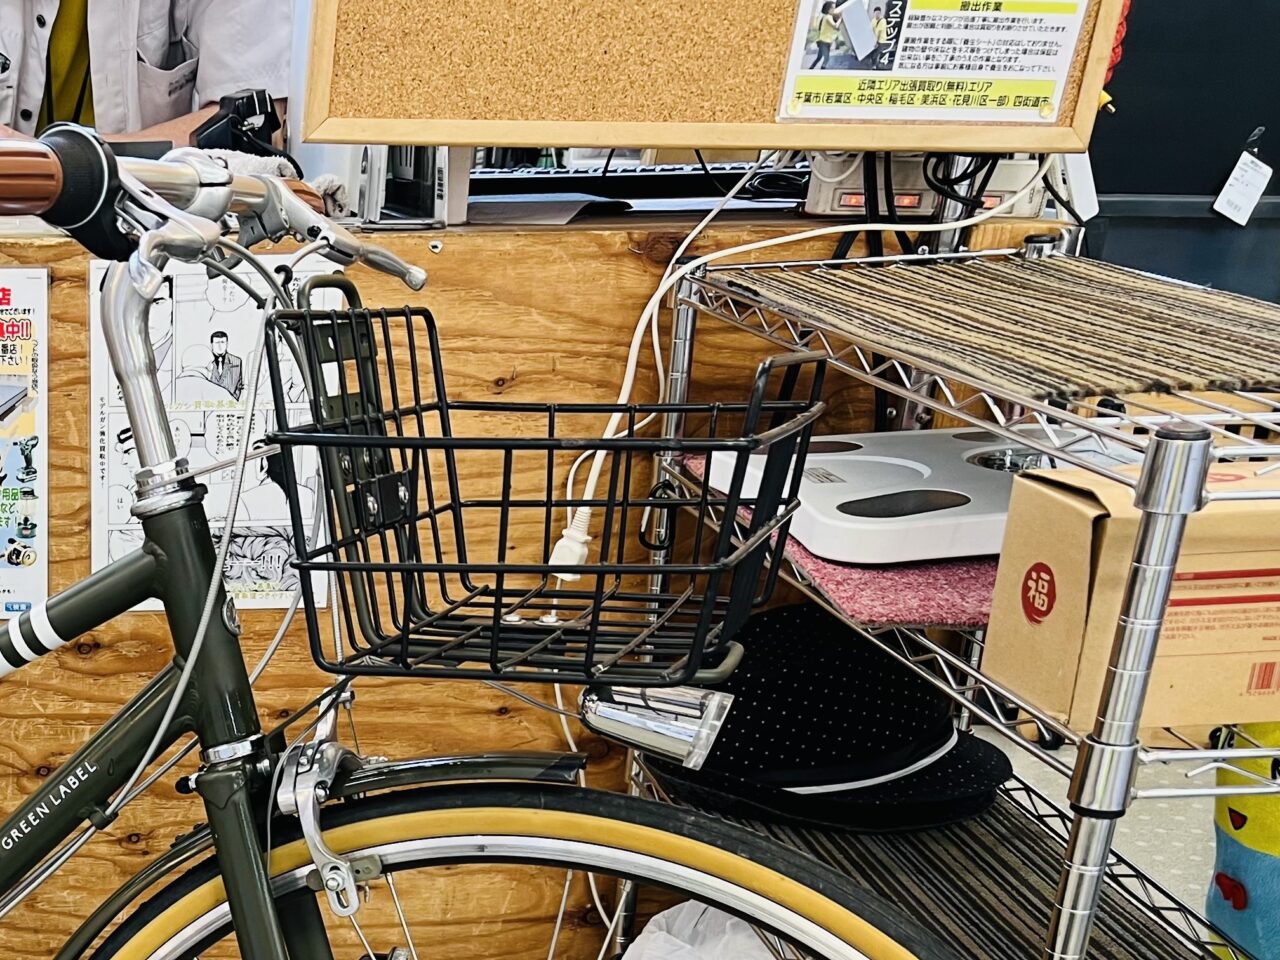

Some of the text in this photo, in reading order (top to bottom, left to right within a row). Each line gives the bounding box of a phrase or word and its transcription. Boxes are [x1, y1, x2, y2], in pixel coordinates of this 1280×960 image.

[1027, 570, 1051, 610] 福
[1, 802, 51, 850] GREEN
[50, 761, 98, 805] LABEL
